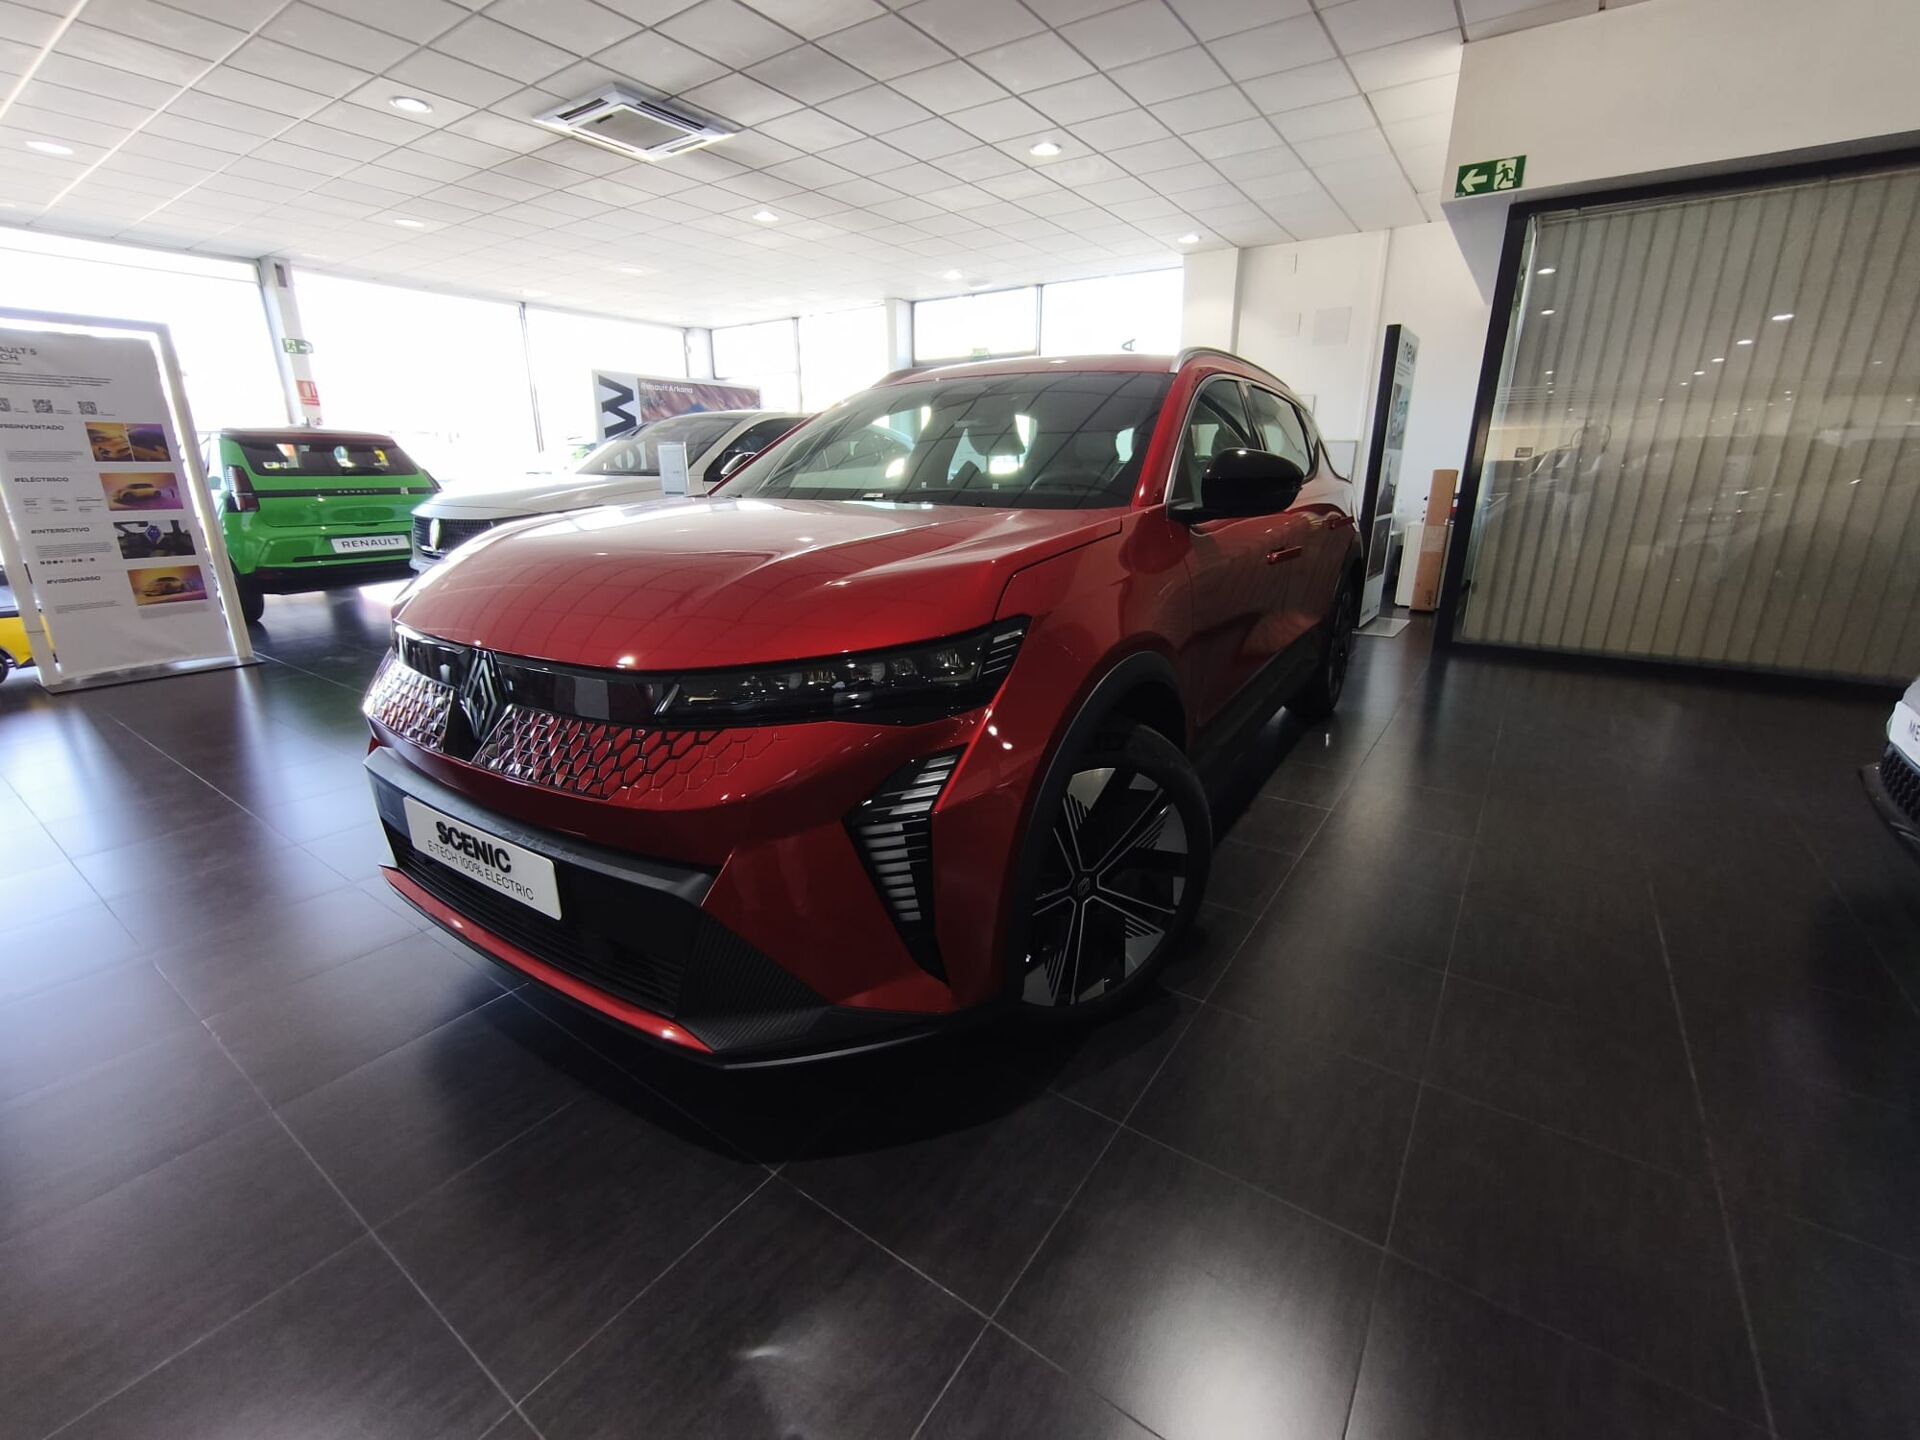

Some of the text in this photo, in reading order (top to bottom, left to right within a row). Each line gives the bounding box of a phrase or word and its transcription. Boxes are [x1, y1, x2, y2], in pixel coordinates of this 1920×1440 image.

[668, 384, 694, 394] Arkana
[341, 538, 400, 548] RENAULT
[436, 821, 512, 873] SCENIC
[427, 840, 534, 901] E-TECH 100% ELECTRIC
